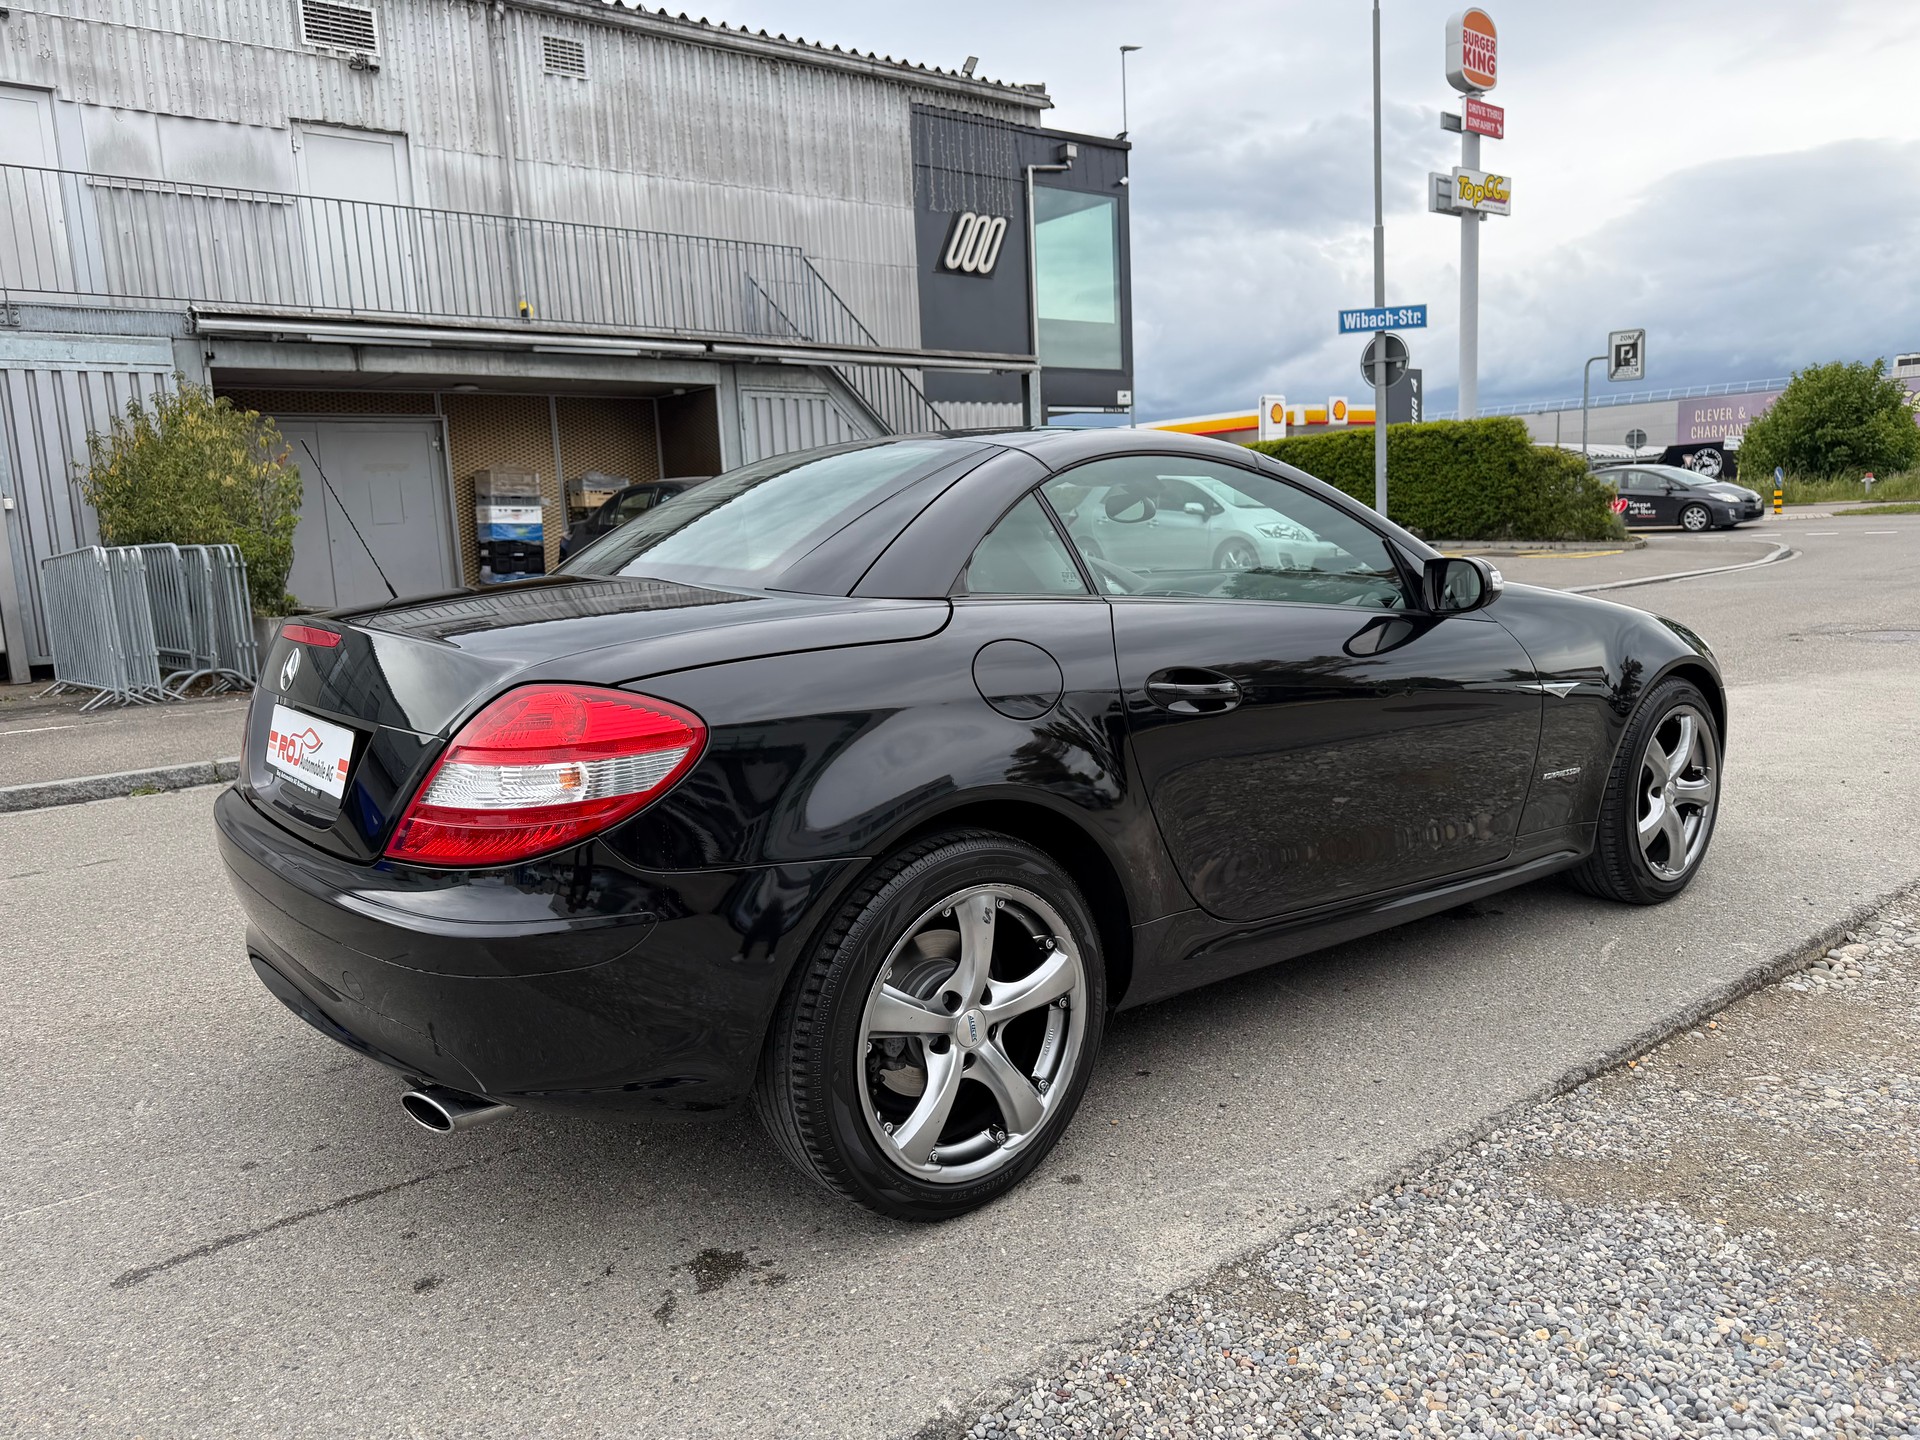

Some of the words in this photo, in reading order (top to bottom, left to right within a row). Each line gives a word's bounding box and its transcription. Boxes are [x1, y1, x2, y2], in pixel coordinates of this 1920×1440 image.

[1463, 30, 1496, 55] BURGER
[1463, 44, 1496, 76] KING
[1468, 102, 1486, 115] DRIVE
[1486, 107, 1502, 121] THRU
[1343, 309, 1422, 330] Wibach-Str.
[1695, 407, 1733, 423] CLEVER
[1738, 406, 1746, 419] &
[1691, 422, 1749, 440] CHARMANT
[277, 734, 303, 766] ROJ
[299, 753, 326, 779] Automobile
[325, 764, 335, 782] AG
